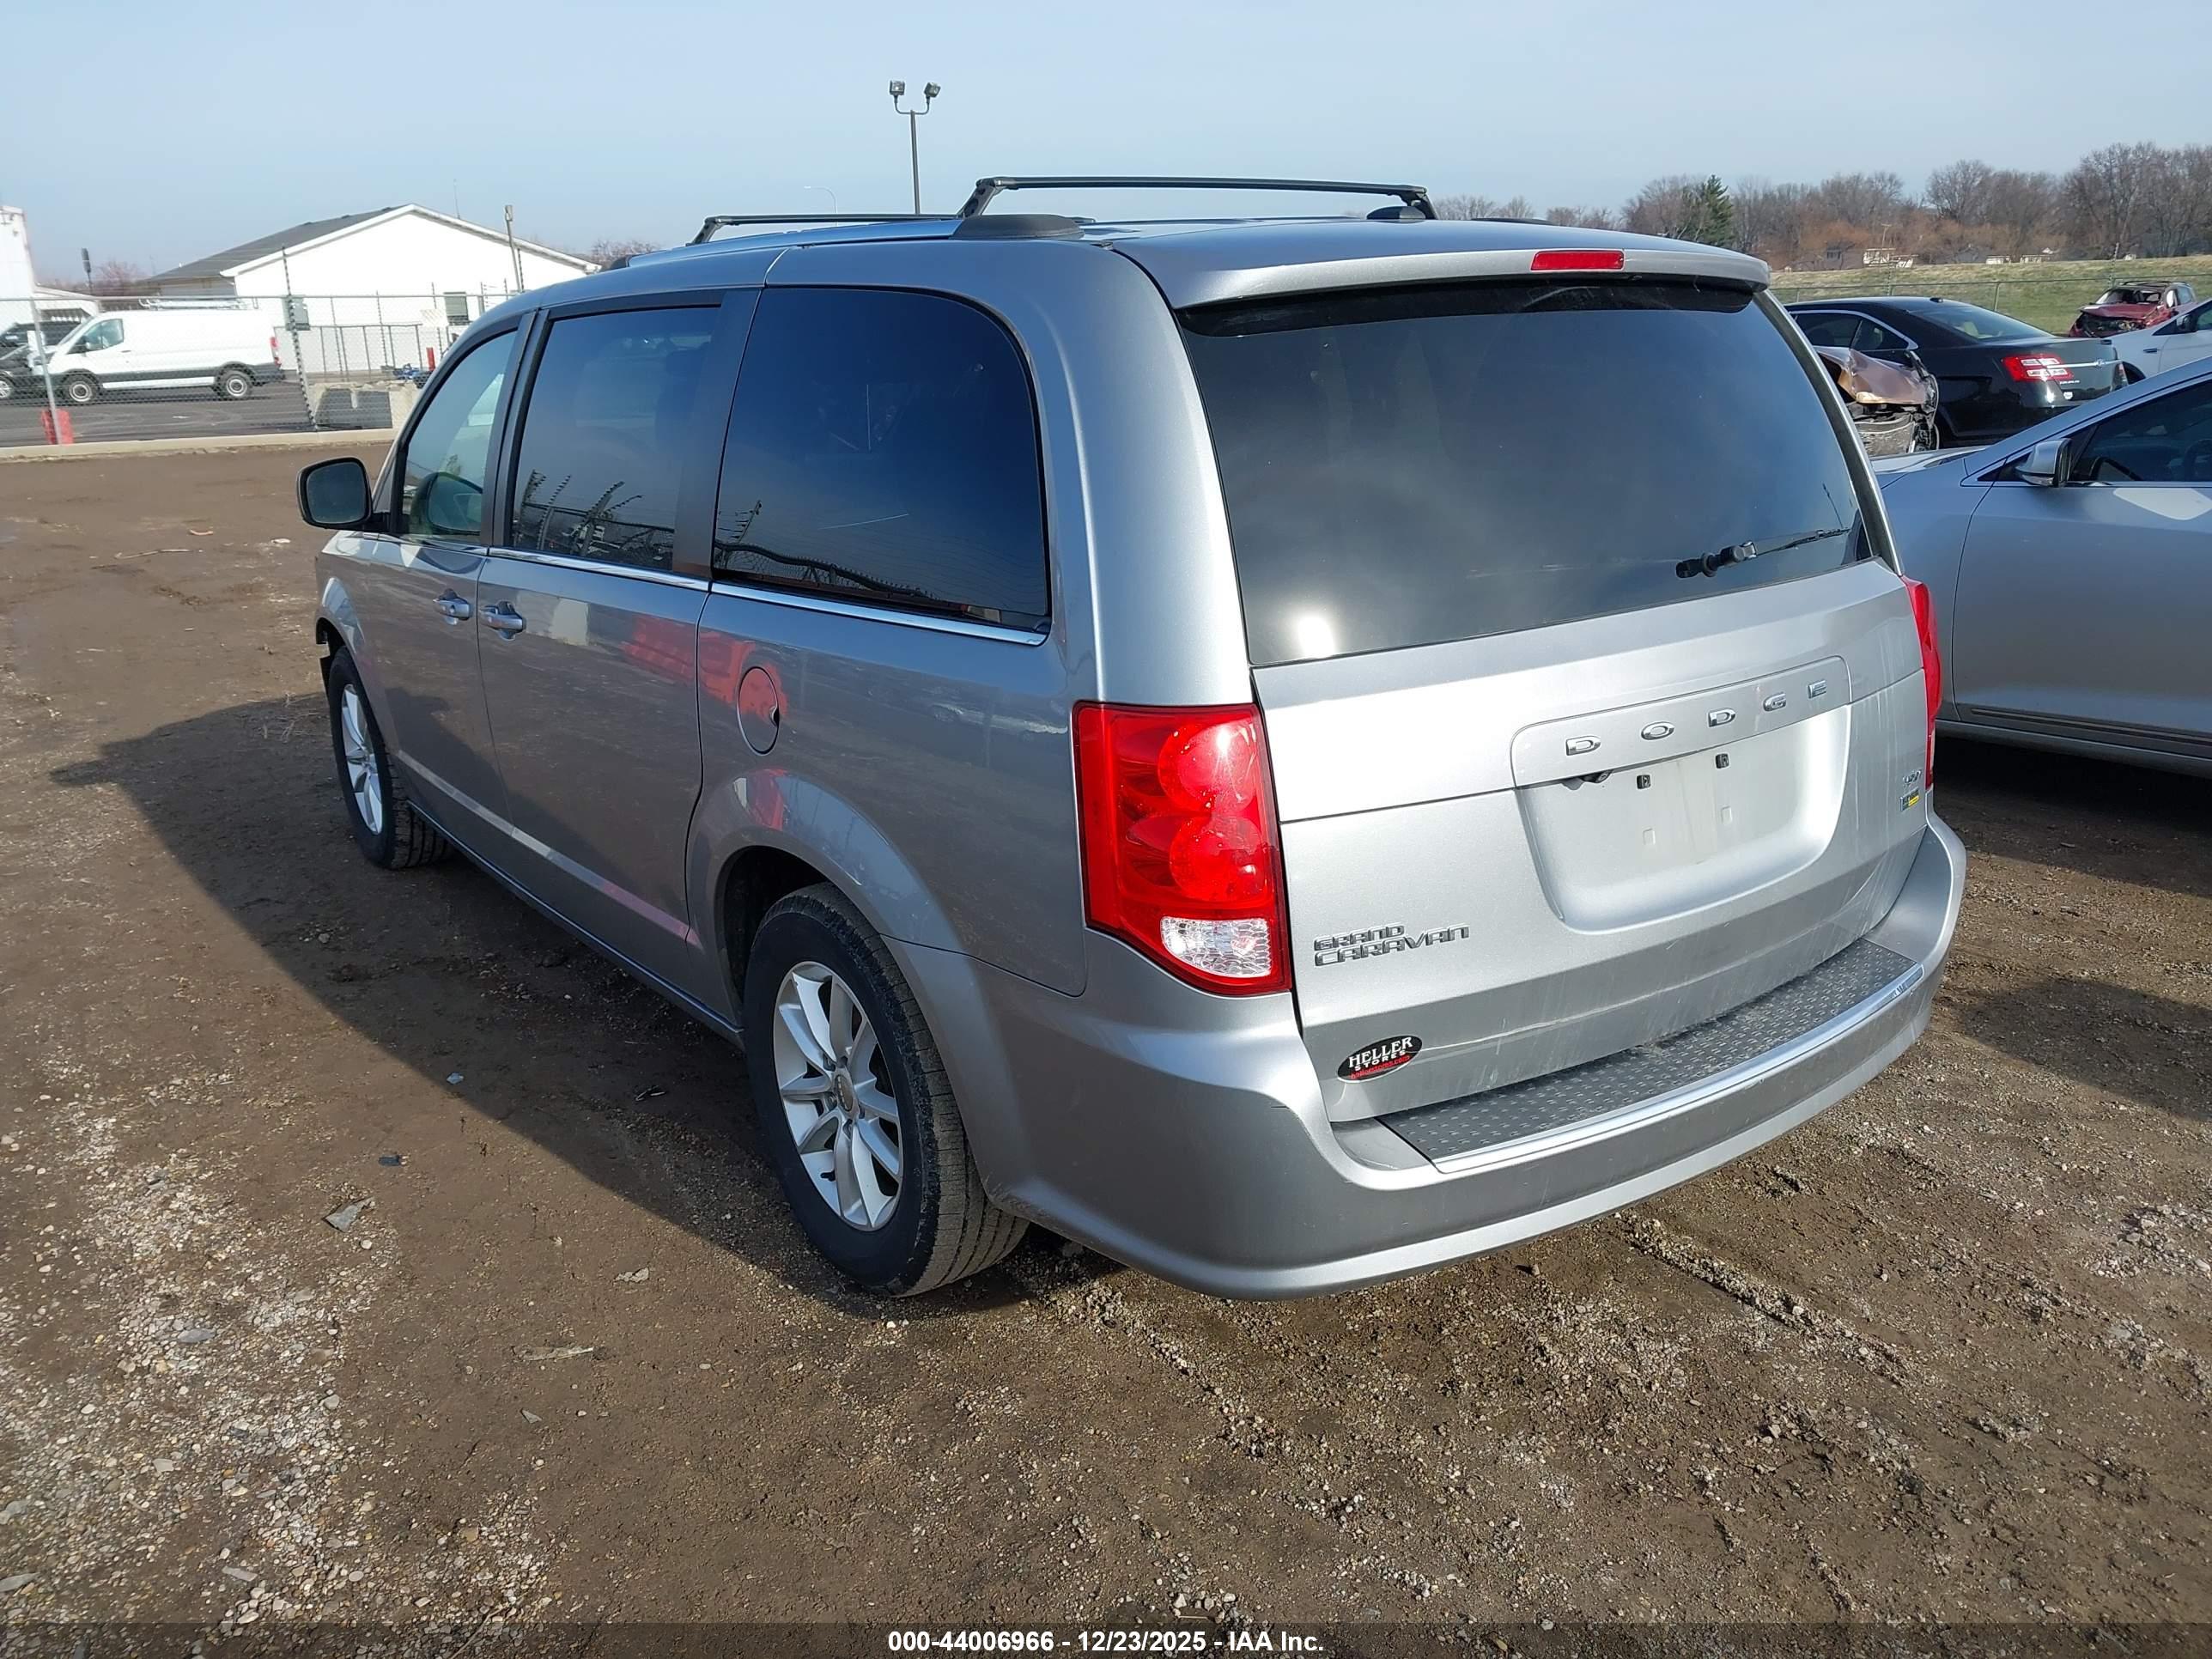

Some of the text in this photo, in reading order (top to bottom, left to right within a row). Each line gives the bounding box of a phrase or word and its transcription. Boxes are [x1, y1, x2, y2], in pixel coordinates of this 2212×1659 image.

[1565, 680, 1826, 756] DODGE
[1314, 923, 1405, 951] GRAND
[1314, 924, 1470, 967] CARAVAN
[1348, 1036, 1413, 1068] HELLER
[1354, 1049, 1406, 1072] STORES
